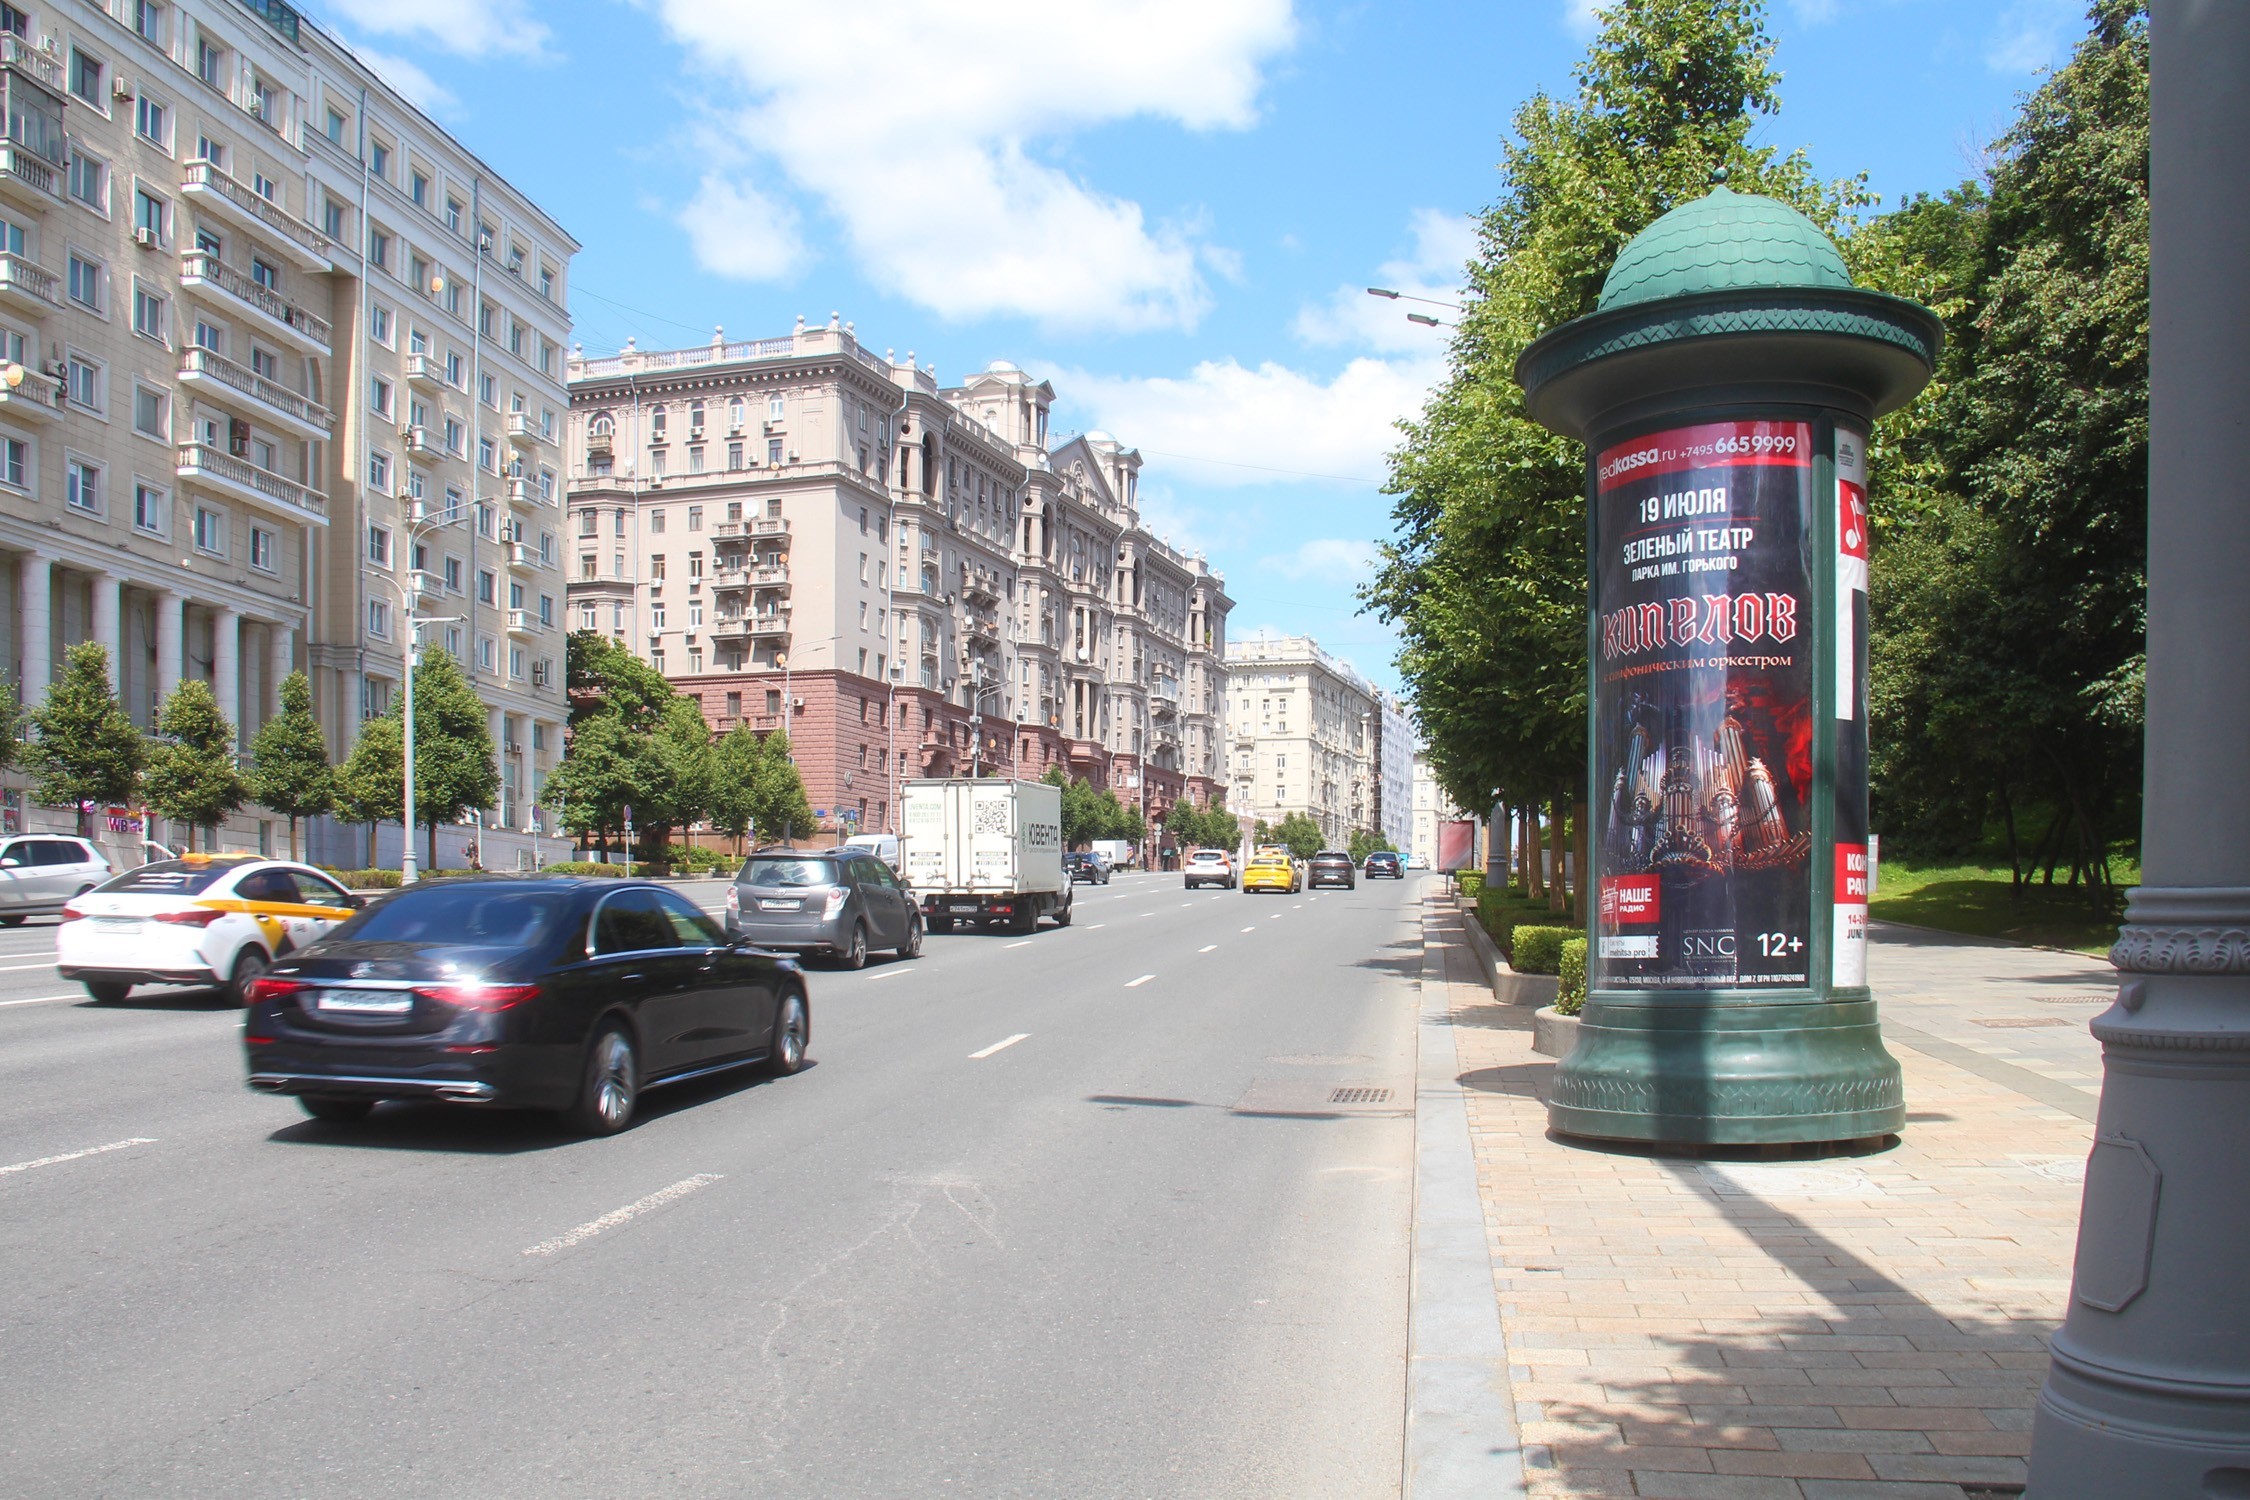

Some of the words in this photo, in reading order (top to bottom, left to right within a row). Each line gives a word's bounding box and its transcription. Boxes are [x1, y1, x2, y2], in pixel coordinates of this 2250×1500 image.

[1600, 448, 1676, 480] redkassa.ru
[1640, 497, 1659, 523] 19
[1664, 488, 1726, 519] ИЮЛЯ
[1623, 527, 1693, 565] ЗЕЛЕНЫЙ
[1697, 528, 1753, 551] ТЕАТР
[1632, 565, 1660, 582] ПАРКА
[1662, 562, 1680, 576] ИМ.
[1683, 556, 1738, 573] ГОРЬКОГО
[1708, 656, 1791, 671] оркестром
[1029, 823, 1058, 846] ЮВЕНТА
[1619, 887, 1652, 903] НАШЕ
[1619, 904, 1645, 913] РАДИО
[1683, 936, 1735, 956] SNC
[1757, 932, 1803, 957] 12+
